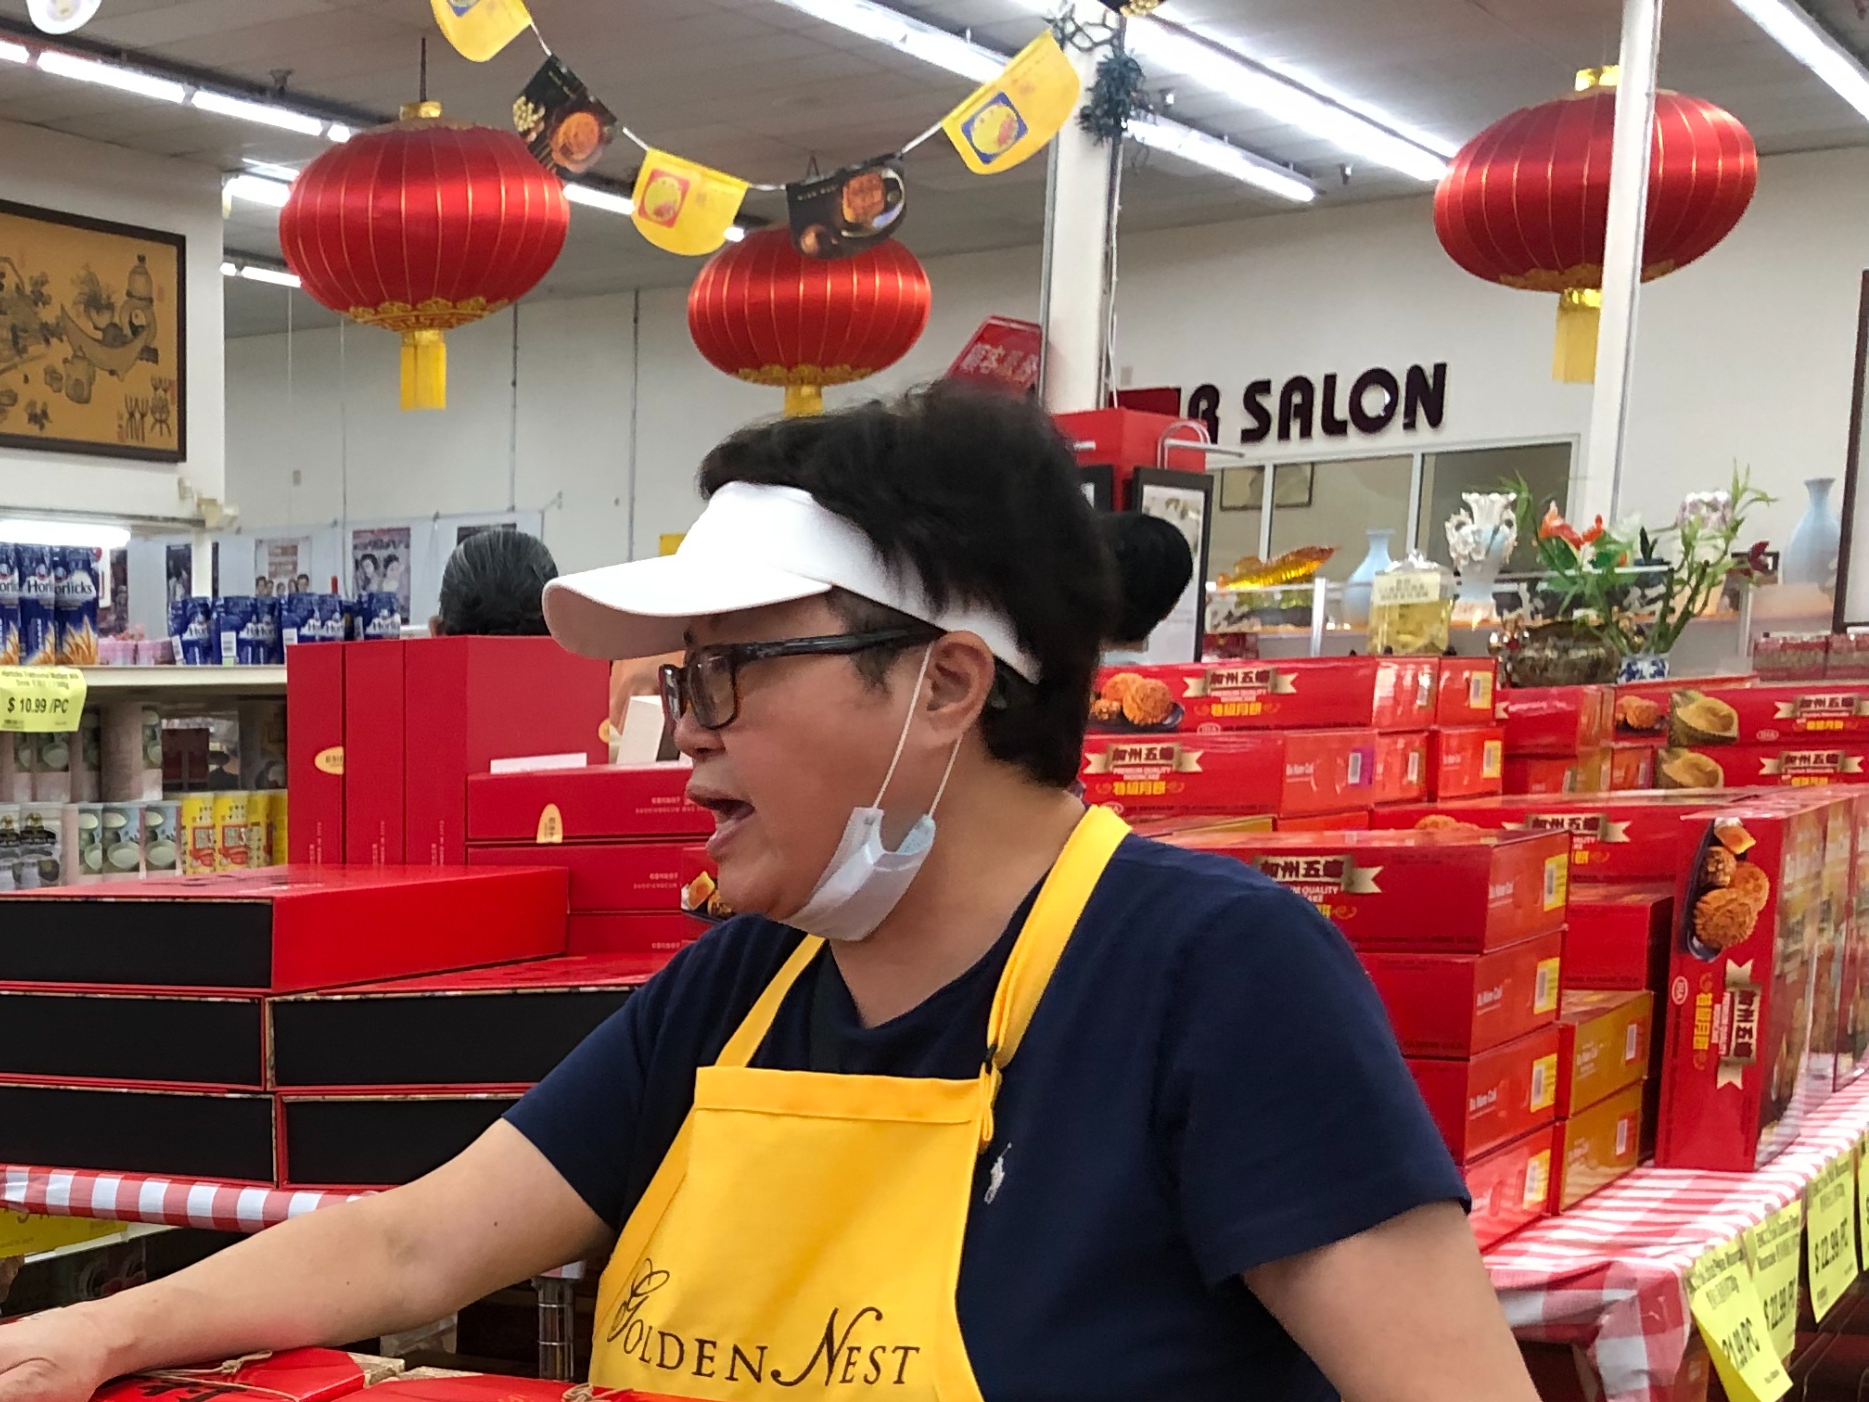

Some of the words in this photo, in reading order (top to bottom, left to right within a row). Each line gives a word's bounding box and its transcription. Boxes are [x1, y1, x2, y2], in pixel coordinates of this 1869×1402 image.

[1240, 362, 1449, 444] SALON
[55, 579, 95, 595] orlicks
[8, 697, 15, 713] $
[20, 698, 47, 713] 10.99
[50, 698, 69, 713] /PC
[1302, 885, 1339, 895] QUALITY
